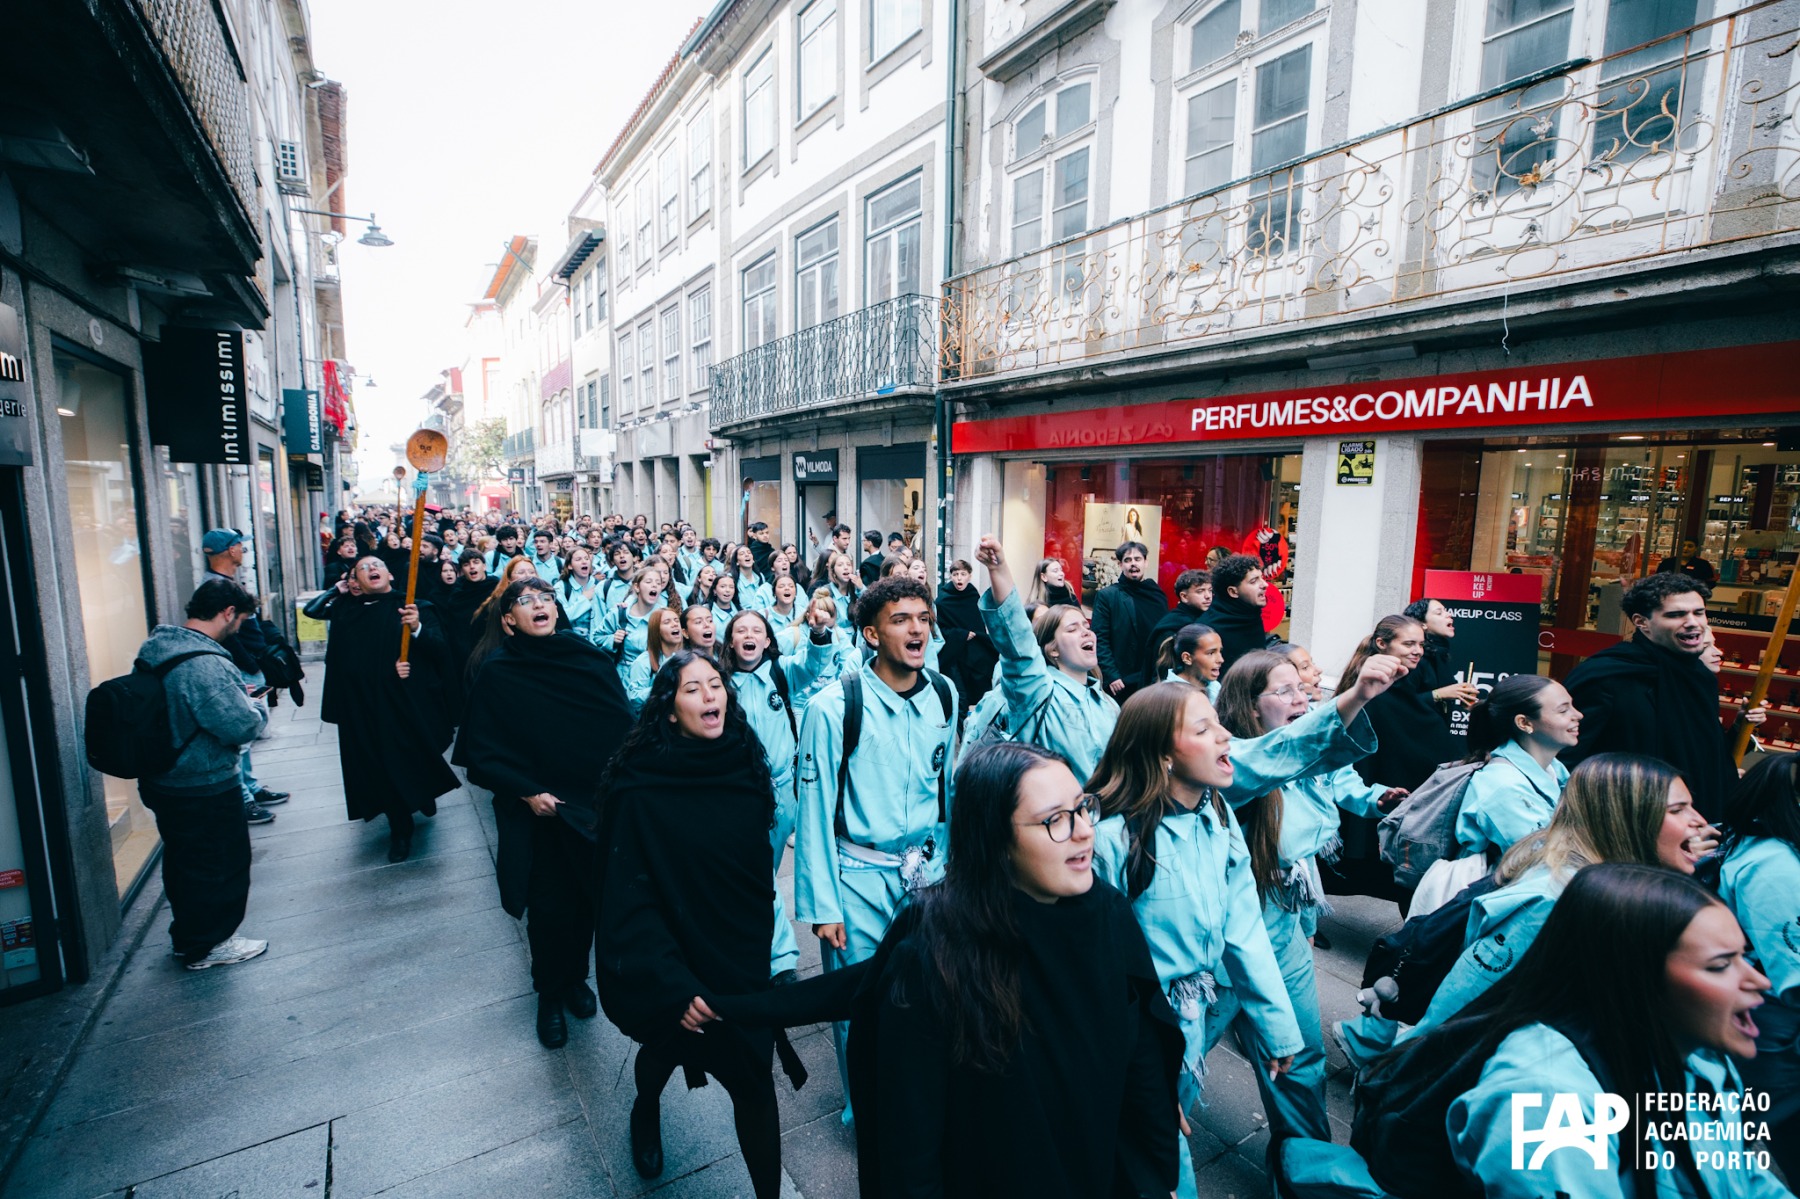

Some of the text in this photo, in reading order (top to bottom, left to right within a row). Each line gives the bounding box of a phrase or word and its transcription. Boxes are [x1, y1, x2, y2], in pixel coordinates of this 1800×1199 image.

[217, 332, 240, 462] intimissimi
[1190, 375, 1594, 431] PERFUMES&COMPANHIA
[307, 393, 321, 451] CALZEDONIA
[806, 461, 832, 473] VILMODA
[1473, 575, 1486, 583] MA
[1472, 583, 1484, 591] KE
[1472, 591, 1485, 599] UP
[1446, 608, 1523, 622] AKEUP CLASS
[1451, 710, 1471, 723] ex
